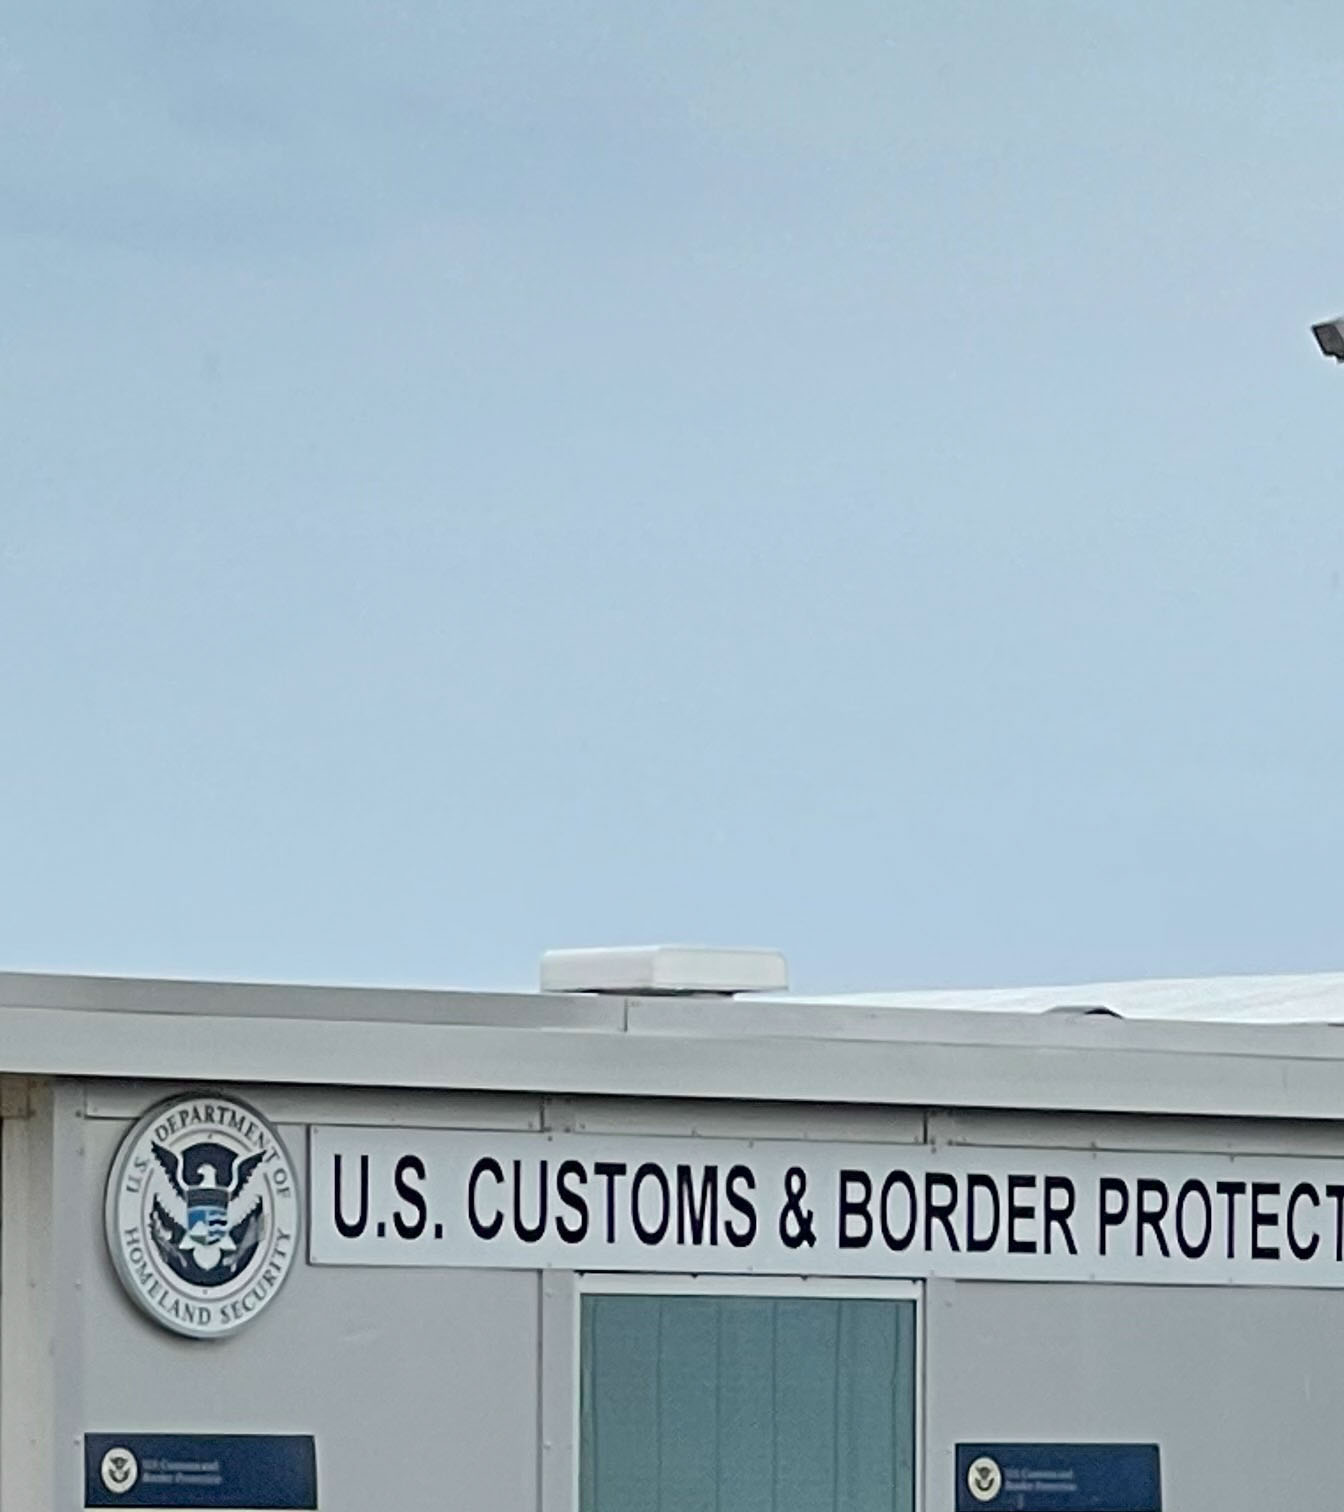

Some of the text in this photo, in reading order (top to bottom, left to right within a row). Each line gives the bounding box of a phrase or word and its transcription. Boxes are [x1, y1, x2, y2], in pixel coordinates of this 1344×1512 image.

[155, 1103, 280, 1164] DEPARTMENT
[272, 1168, 291, 1200] OF
[332, 1153, 444, 1241] U.S.
[467, 1156, 757, 1248] CUSTOMS
[778, 1166, 816, 1250] &
[838, 1168, 1078, 1258] BORDER
[124, 1226, 292, 1326] HOMELAND SECURITY
